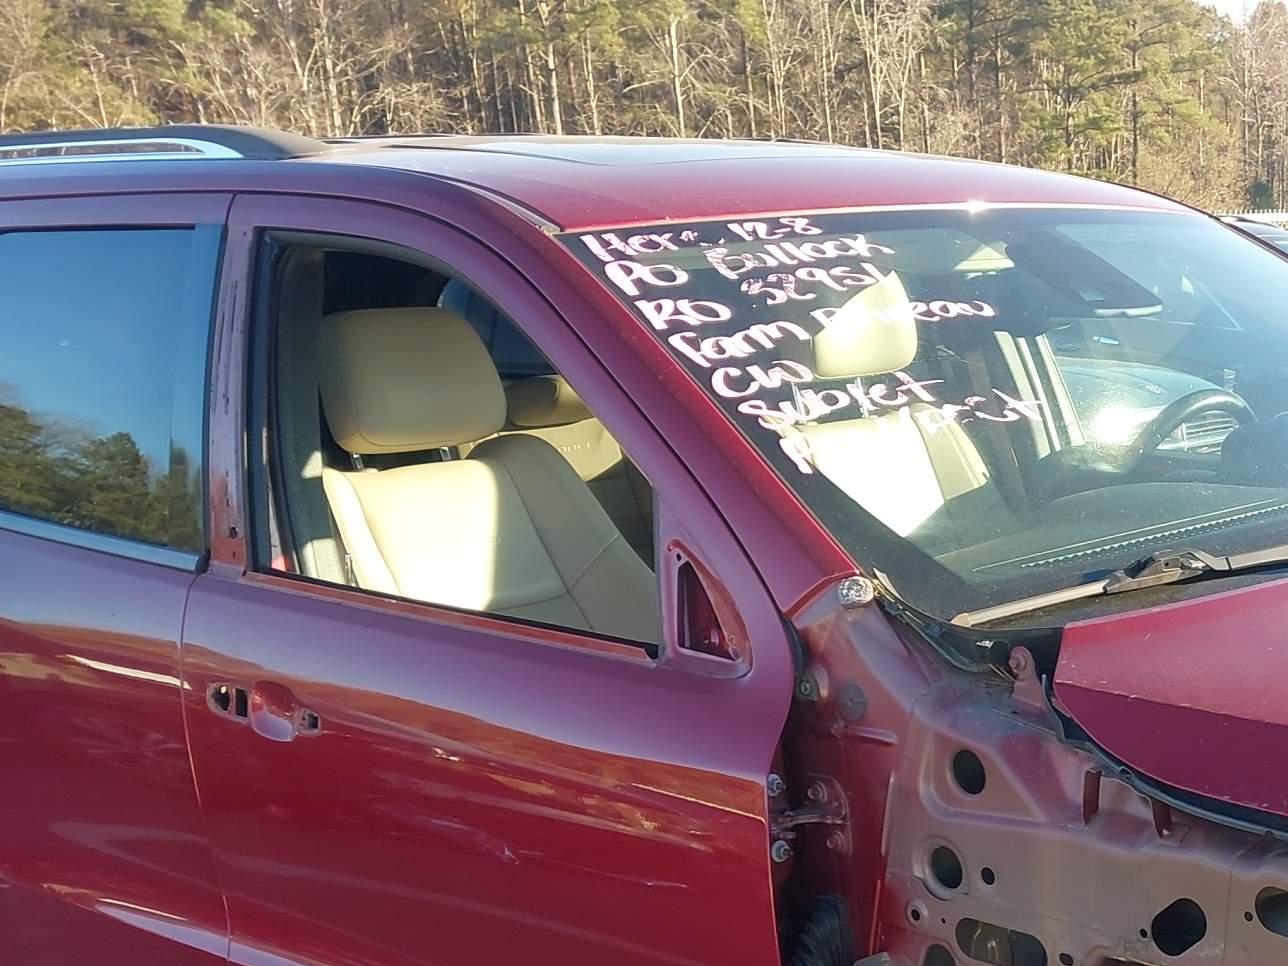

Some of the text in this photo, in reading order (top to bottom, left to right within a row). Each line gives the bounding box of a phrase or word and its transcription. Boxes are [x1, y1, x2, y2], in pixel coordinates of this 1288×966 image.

[727, 217, 823, 242] 12-8
[604, 259, 689, 297] PO
[633, 298, 732, 331] RO
[809, 299, 998, 338] Beau
